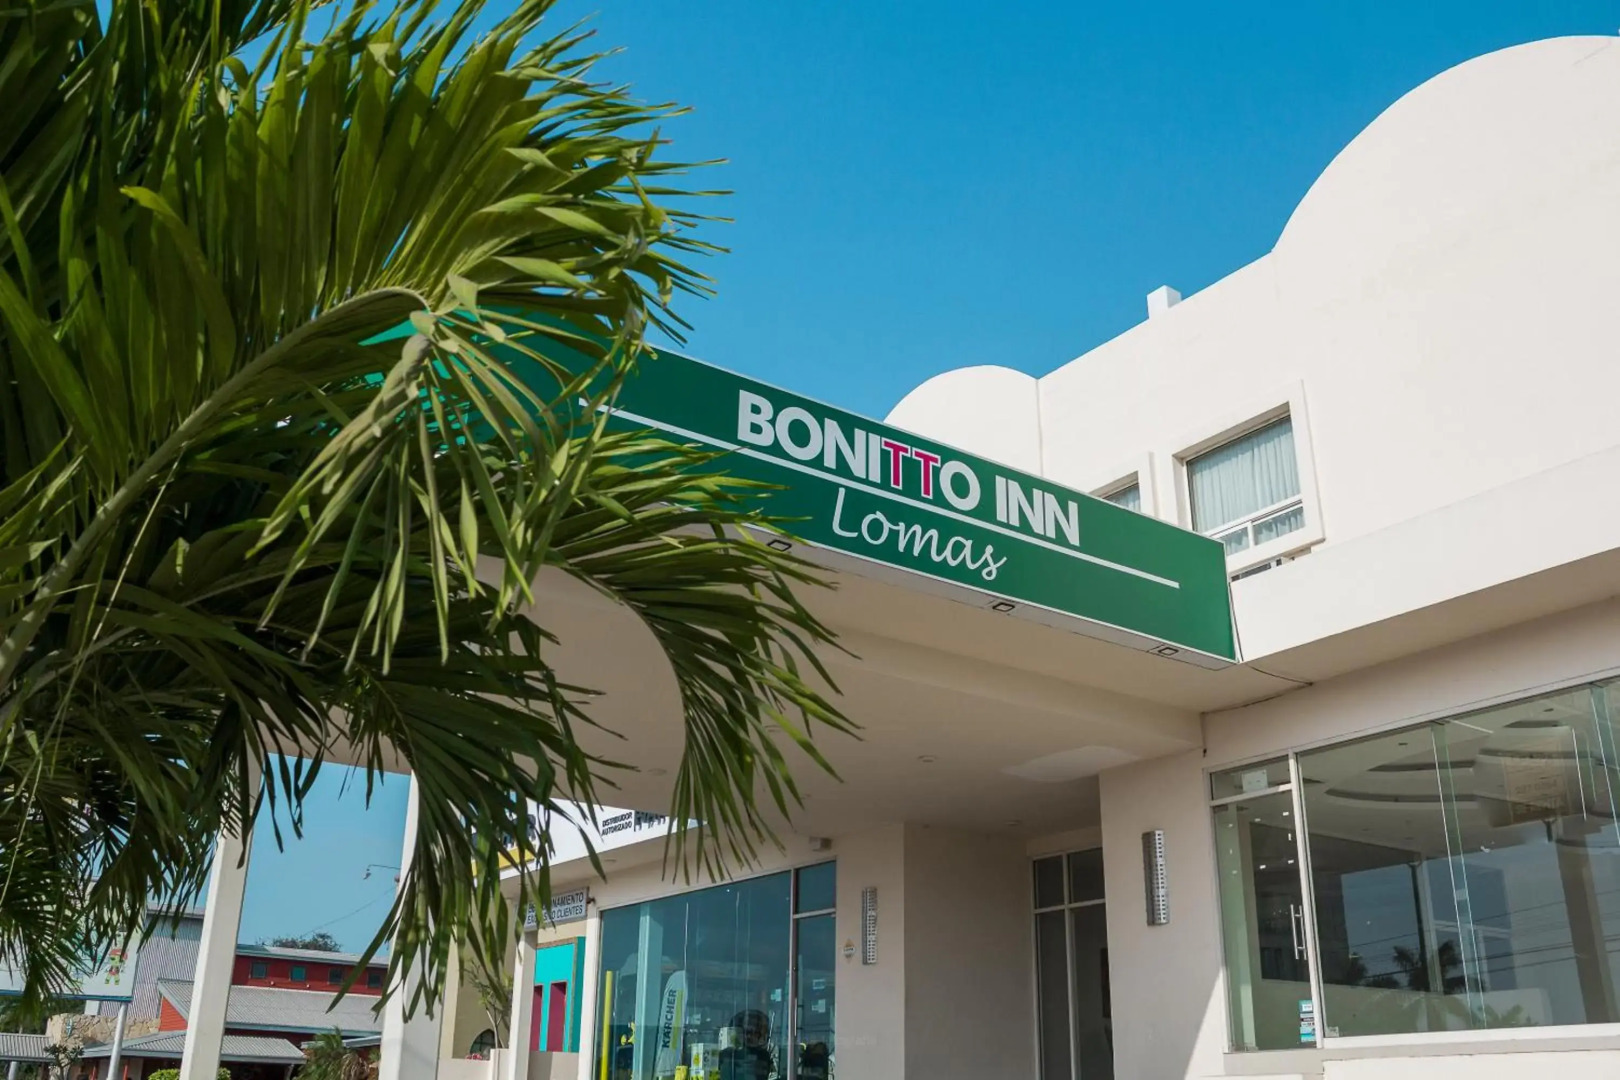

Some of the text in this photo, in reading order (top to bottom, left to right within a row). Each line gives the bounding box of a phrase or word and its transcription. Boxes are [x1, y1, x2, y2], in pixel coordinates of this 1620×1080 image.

[737, 389, 1080, 547] BONITTO INN
[832, 487, 1007, 581] Lomas
[602, 820, 633, 836] AUTORIZADO
[557, 905, 583, 919] CLIENTES
